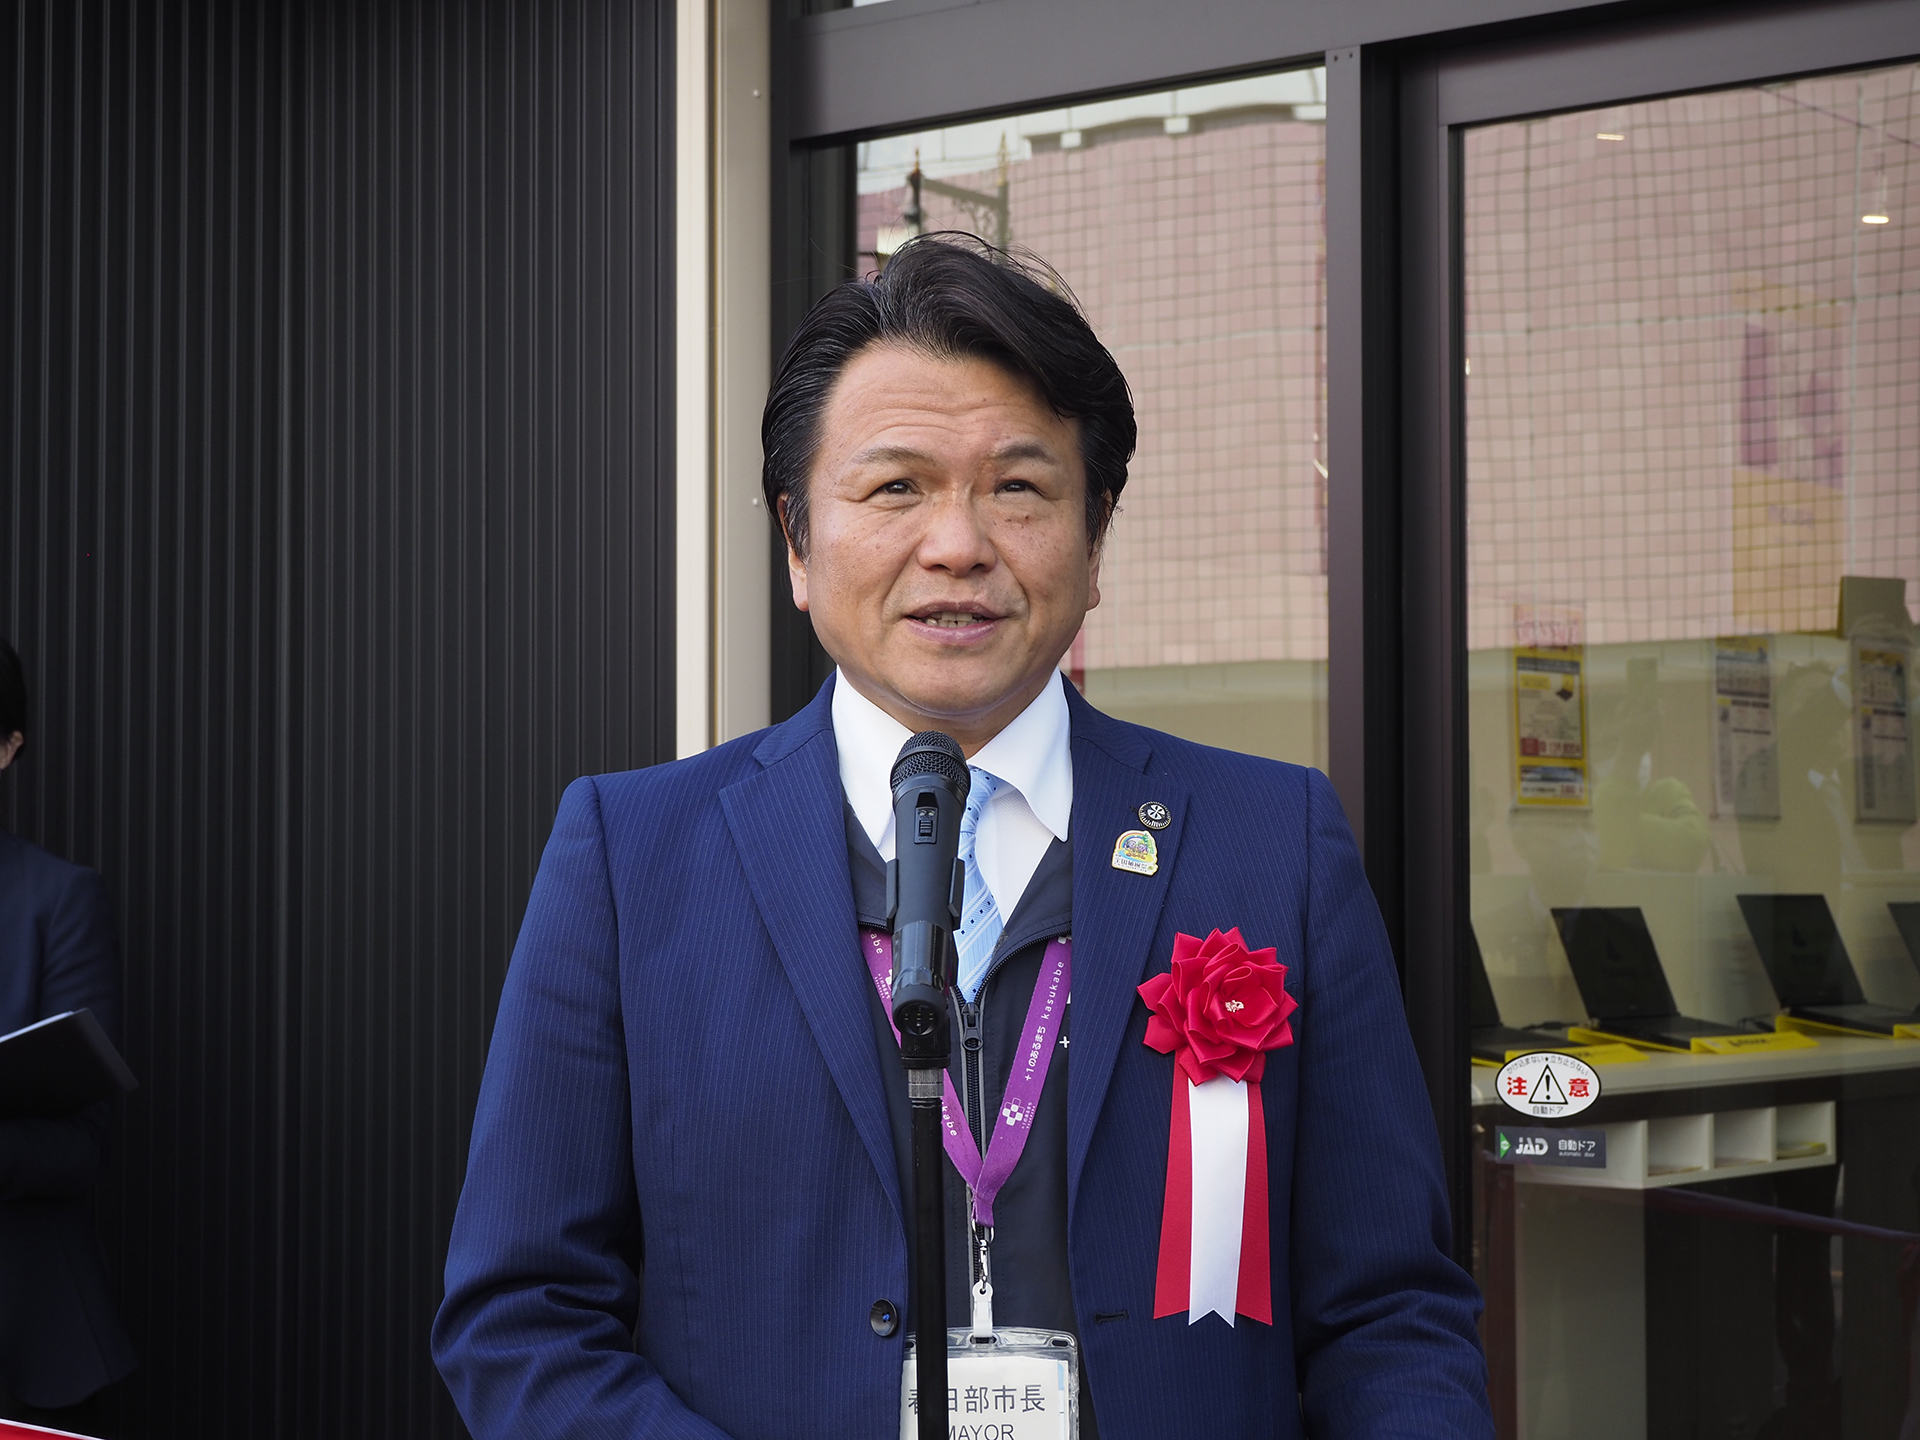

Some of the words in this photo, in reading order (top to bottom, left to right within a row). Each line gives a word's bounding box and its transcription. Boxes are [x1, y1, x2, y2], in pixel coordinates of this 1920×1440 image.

[1041, 961, 1065, 1020] kasukabe
[1532, 1105, 1564, 1115] 自動ドア
[1558, 1139, 1596, 1152] 自動ドア
